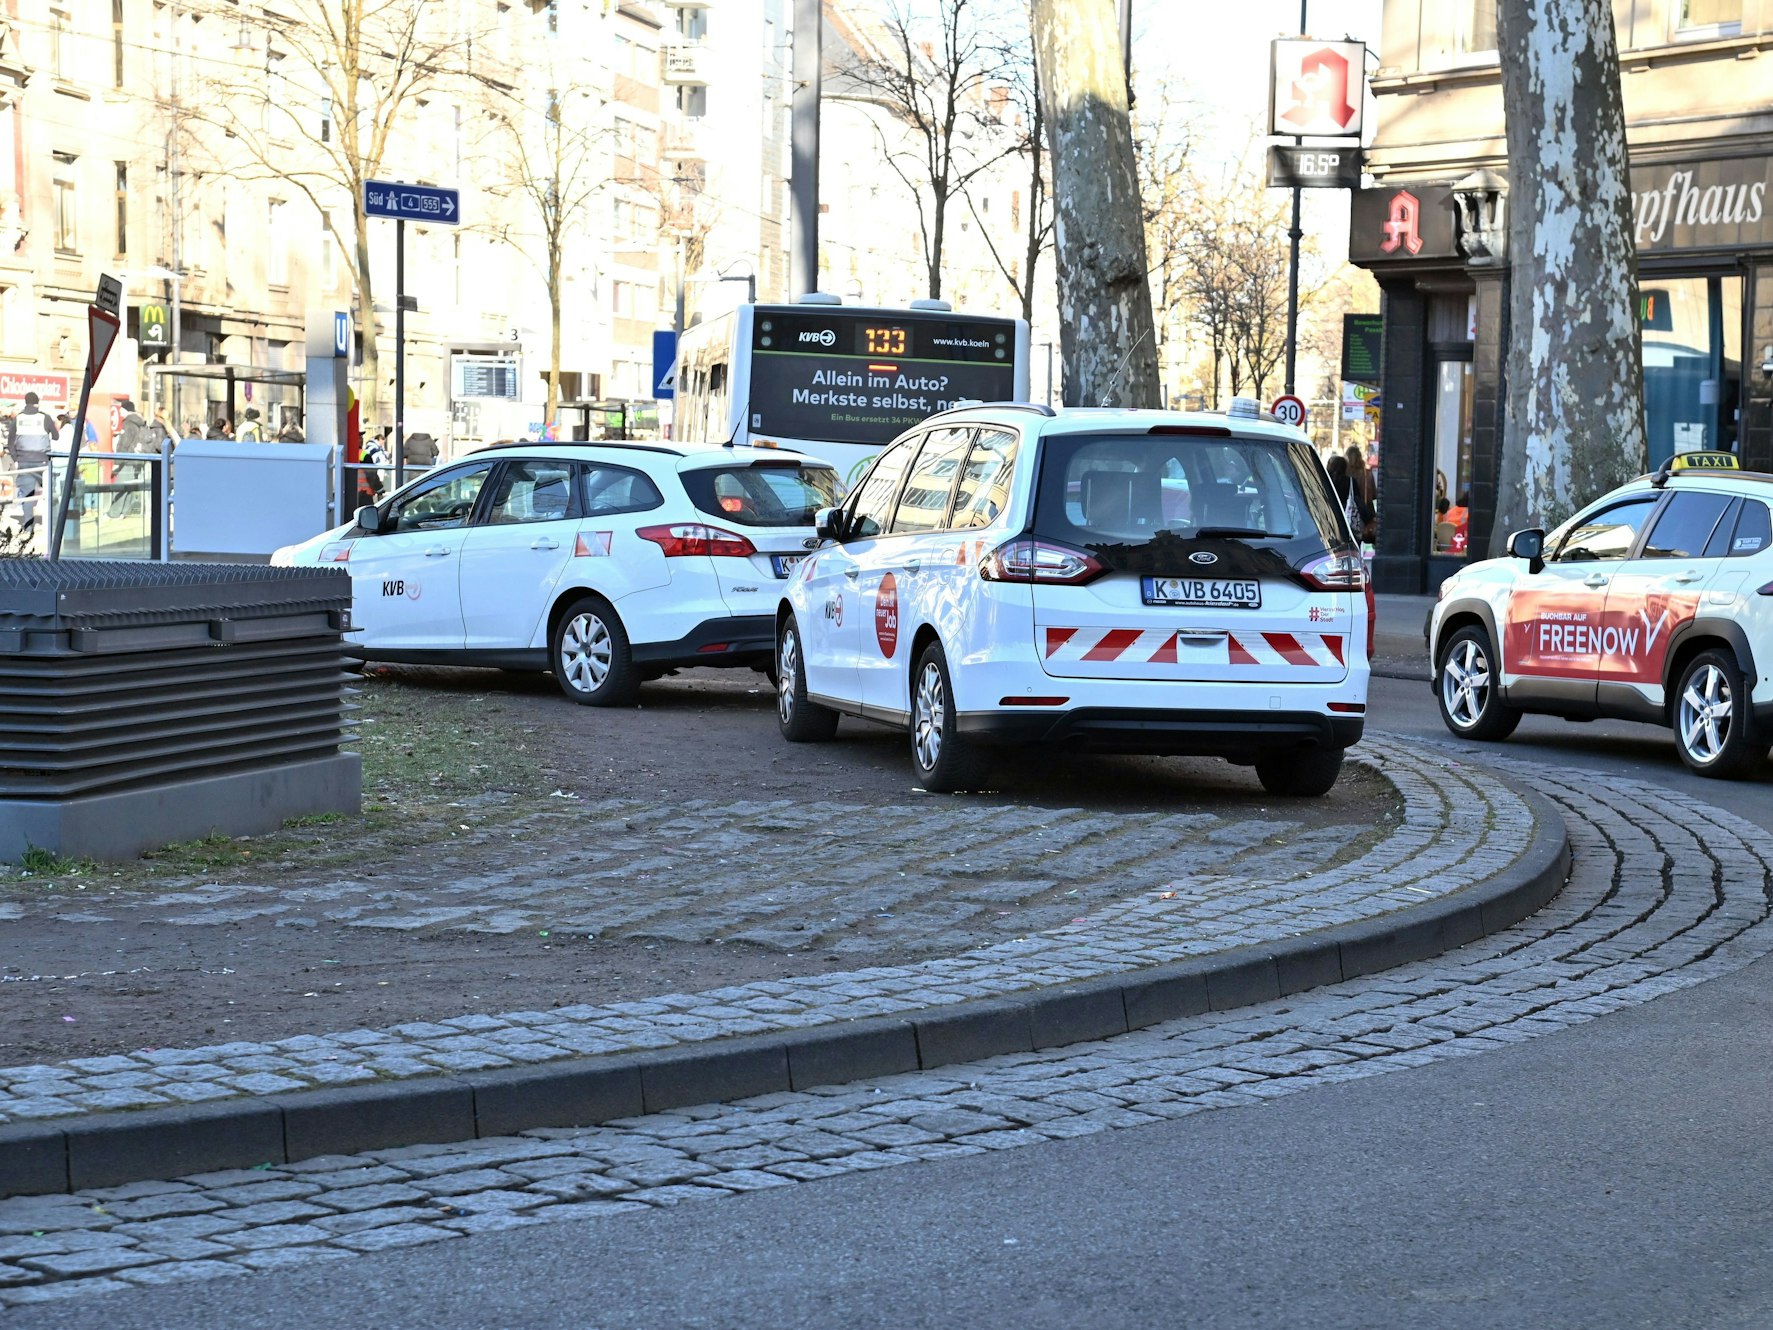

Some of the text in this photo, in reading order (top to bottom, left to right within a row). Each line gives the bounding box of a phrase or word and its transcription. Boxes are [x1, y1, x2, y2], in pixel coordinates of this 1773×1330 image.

[368, 191, 438, 210] Süd 4 555
[1631, 170, 1767, 243] pfhaus
[336, 318, 347, 352] U
[510, 328, 519, 341] 3
[799, 332, 819, 342] KVB
[865, 328, 905, 353] 133
[933, 337, 990, 348] www.kvb.koeln
[1, 375, 61, 399] Chlodwigplatz
[812, 370, 948, 391] Allein im Auto?
[792, 388, 867, 407] Merkste
[872, 393, 932, 412] selbst,
[846, 414, 859, 422] Bus
[1278, 405, 1298, 421] 30
[1692, 456, 1727, 467] TAXI
[781, 558, 791, 573] K
[382, 580, 404, 597] KVB
[1155, 580, 1257, 601] K VB 6405
[825, 601, 836, 620] KVB
[885, 609, 897, 629] Job
[1540, 612, 1587, 622] BUCHBAR AUF
[1539, 624, 1639, 656] FREENOW
